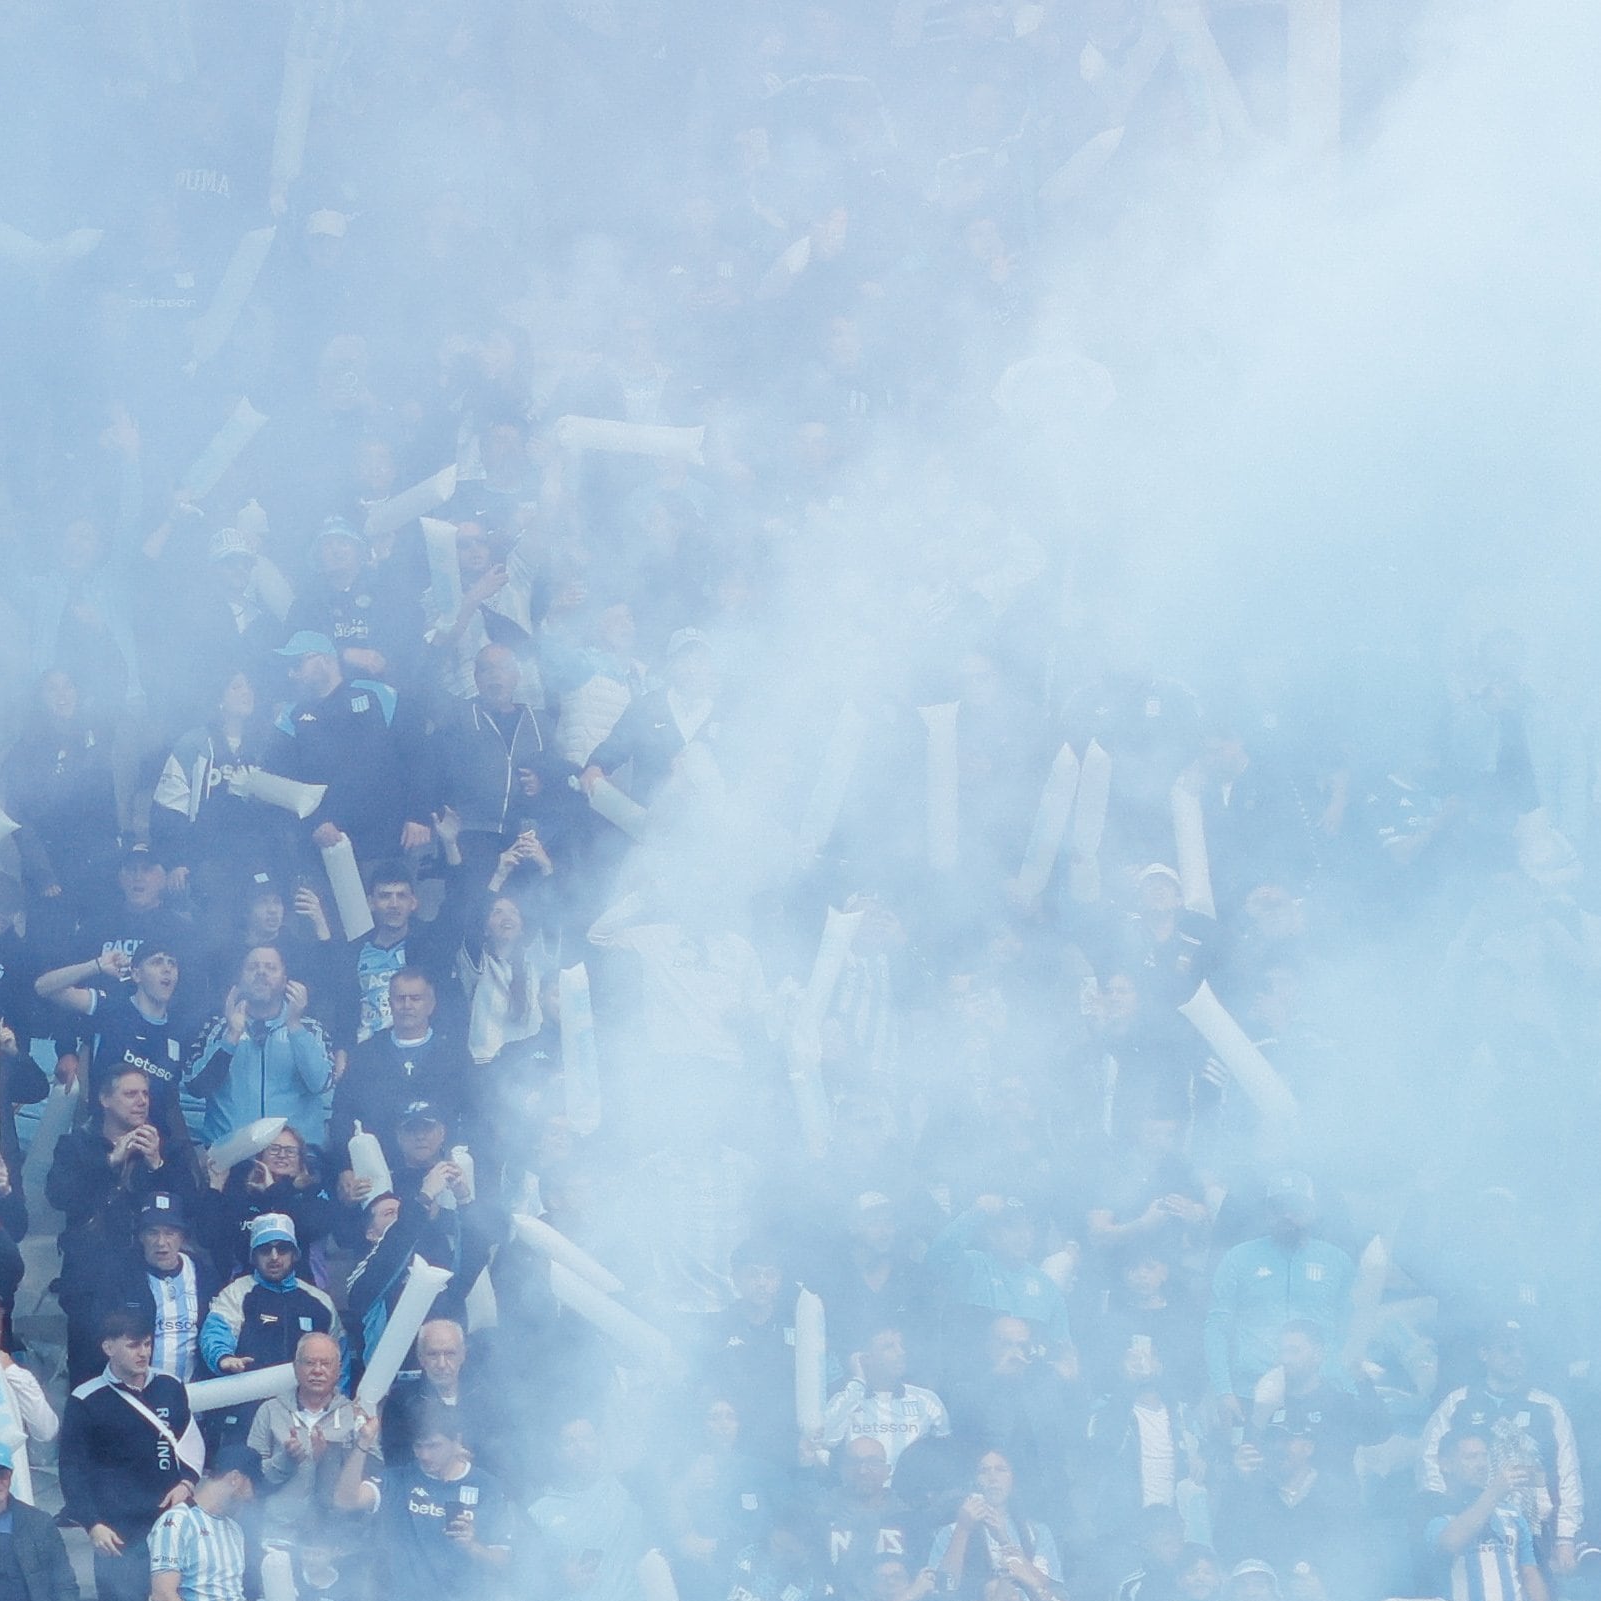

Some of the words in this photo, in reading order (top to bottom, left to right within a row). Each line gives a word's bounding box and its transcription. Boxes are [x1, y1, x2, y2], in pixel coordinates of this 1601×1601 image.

[124, 1049, 175, 1082] betsso
[851, 1421, 920, 1435] betsson
[408, 1499, 475, 1521] betsn
